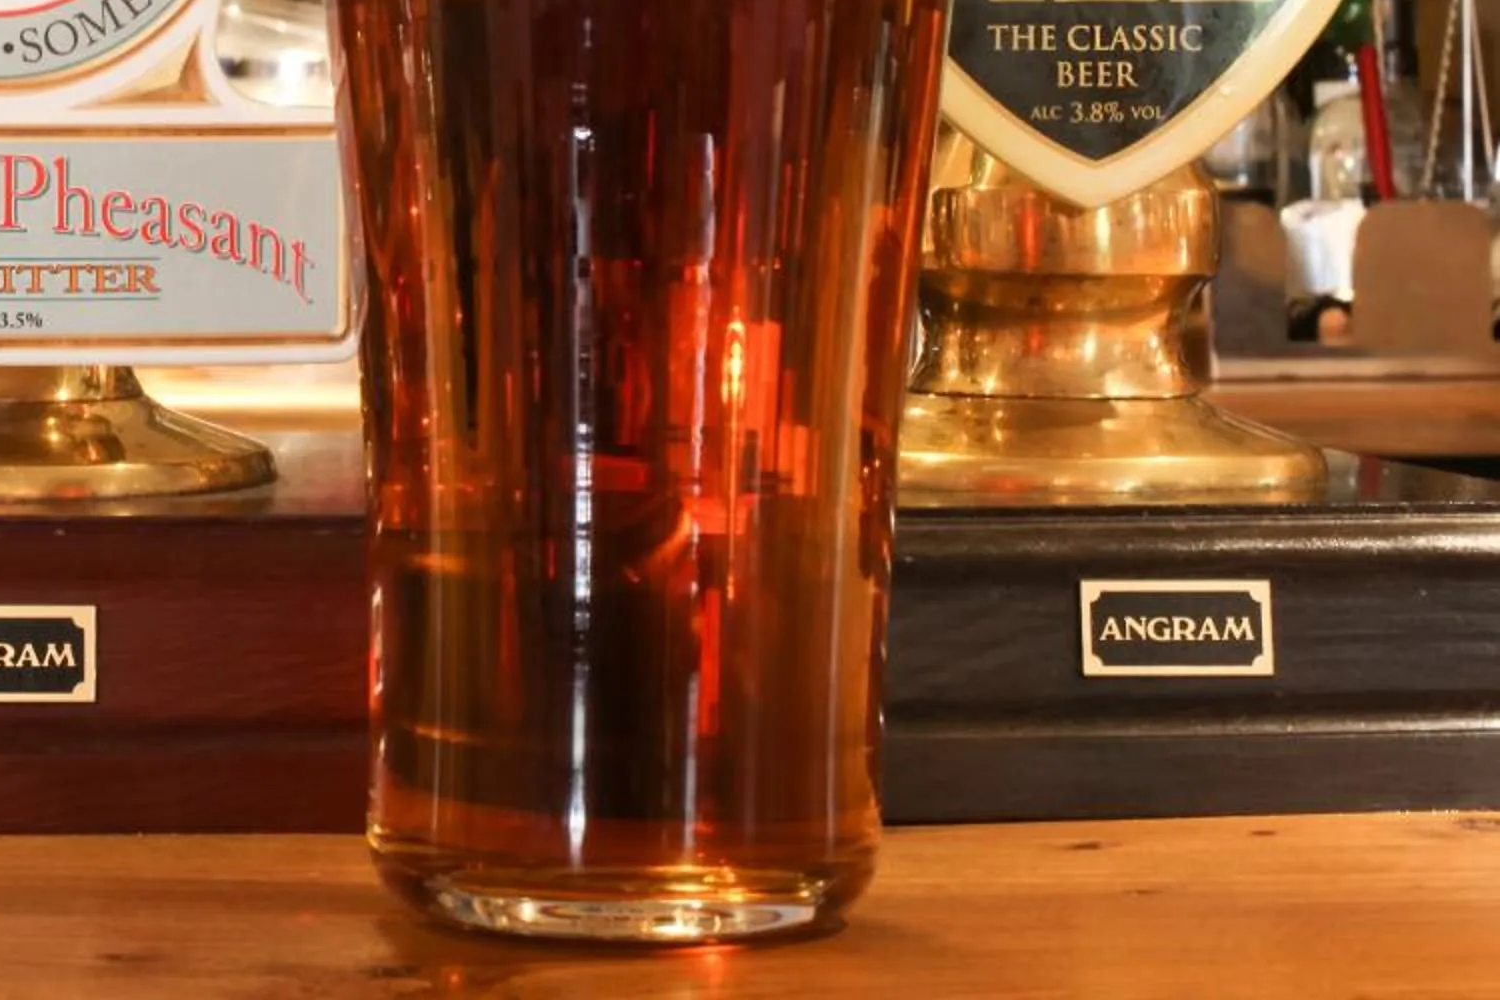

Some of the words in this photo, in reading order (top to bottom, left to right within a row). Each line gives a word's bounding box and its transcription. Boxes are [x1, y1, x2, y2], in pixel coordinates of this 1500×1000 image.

[987, 24, 1057, 51] THE
[1067, 24, 1204, 52] CLASSIC
[1056, 60, 1139, 88] BEER
[1030, 106, 1063, 120] ALC
[1069, 101, 1125, 124] 3.8%
[1130, 106, 1166, 120] VOL
[1099, 615, 1255, 642] ANGRAM
